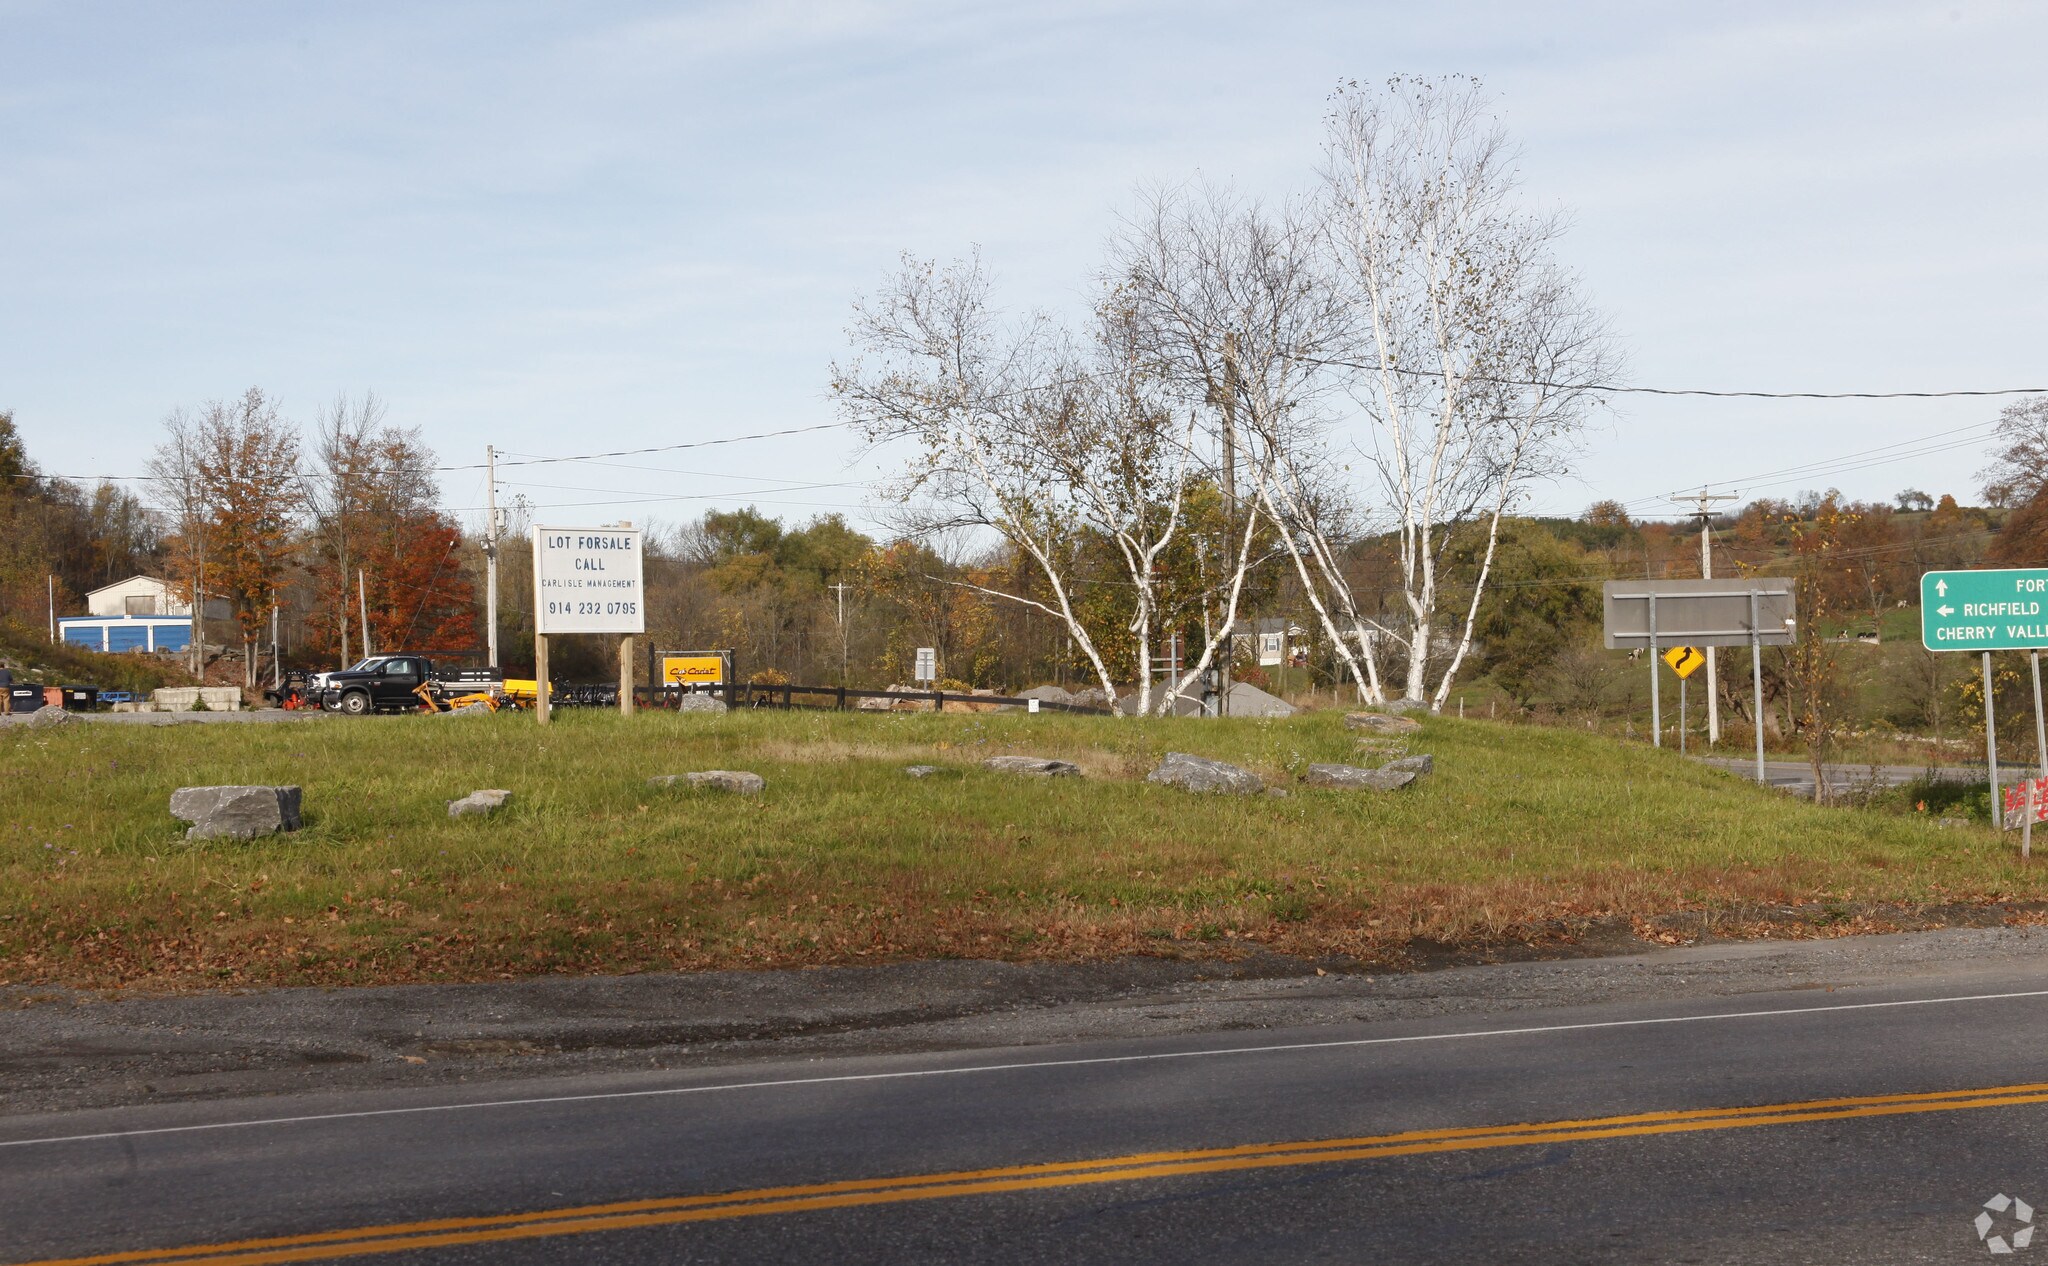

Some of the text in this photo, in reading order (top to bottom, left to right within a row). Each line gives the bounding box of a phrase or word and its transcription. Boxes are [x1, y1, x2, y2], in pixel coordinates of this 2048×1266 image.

[549, 536, 571, 549] LOT
[575, 558, 605, 571] CALL
[542, 579, 635, 588] CARLISLE MANAGEMENT
[2016, 579, 2048, 592] FOR
[549, 602, 636, 615] 914 232 0795
[1964, 602, 2040, 616] RICHFIELD
[1937, 626, 1996, 641] CHERRY
[688, 667, 717, 675] Cadet
